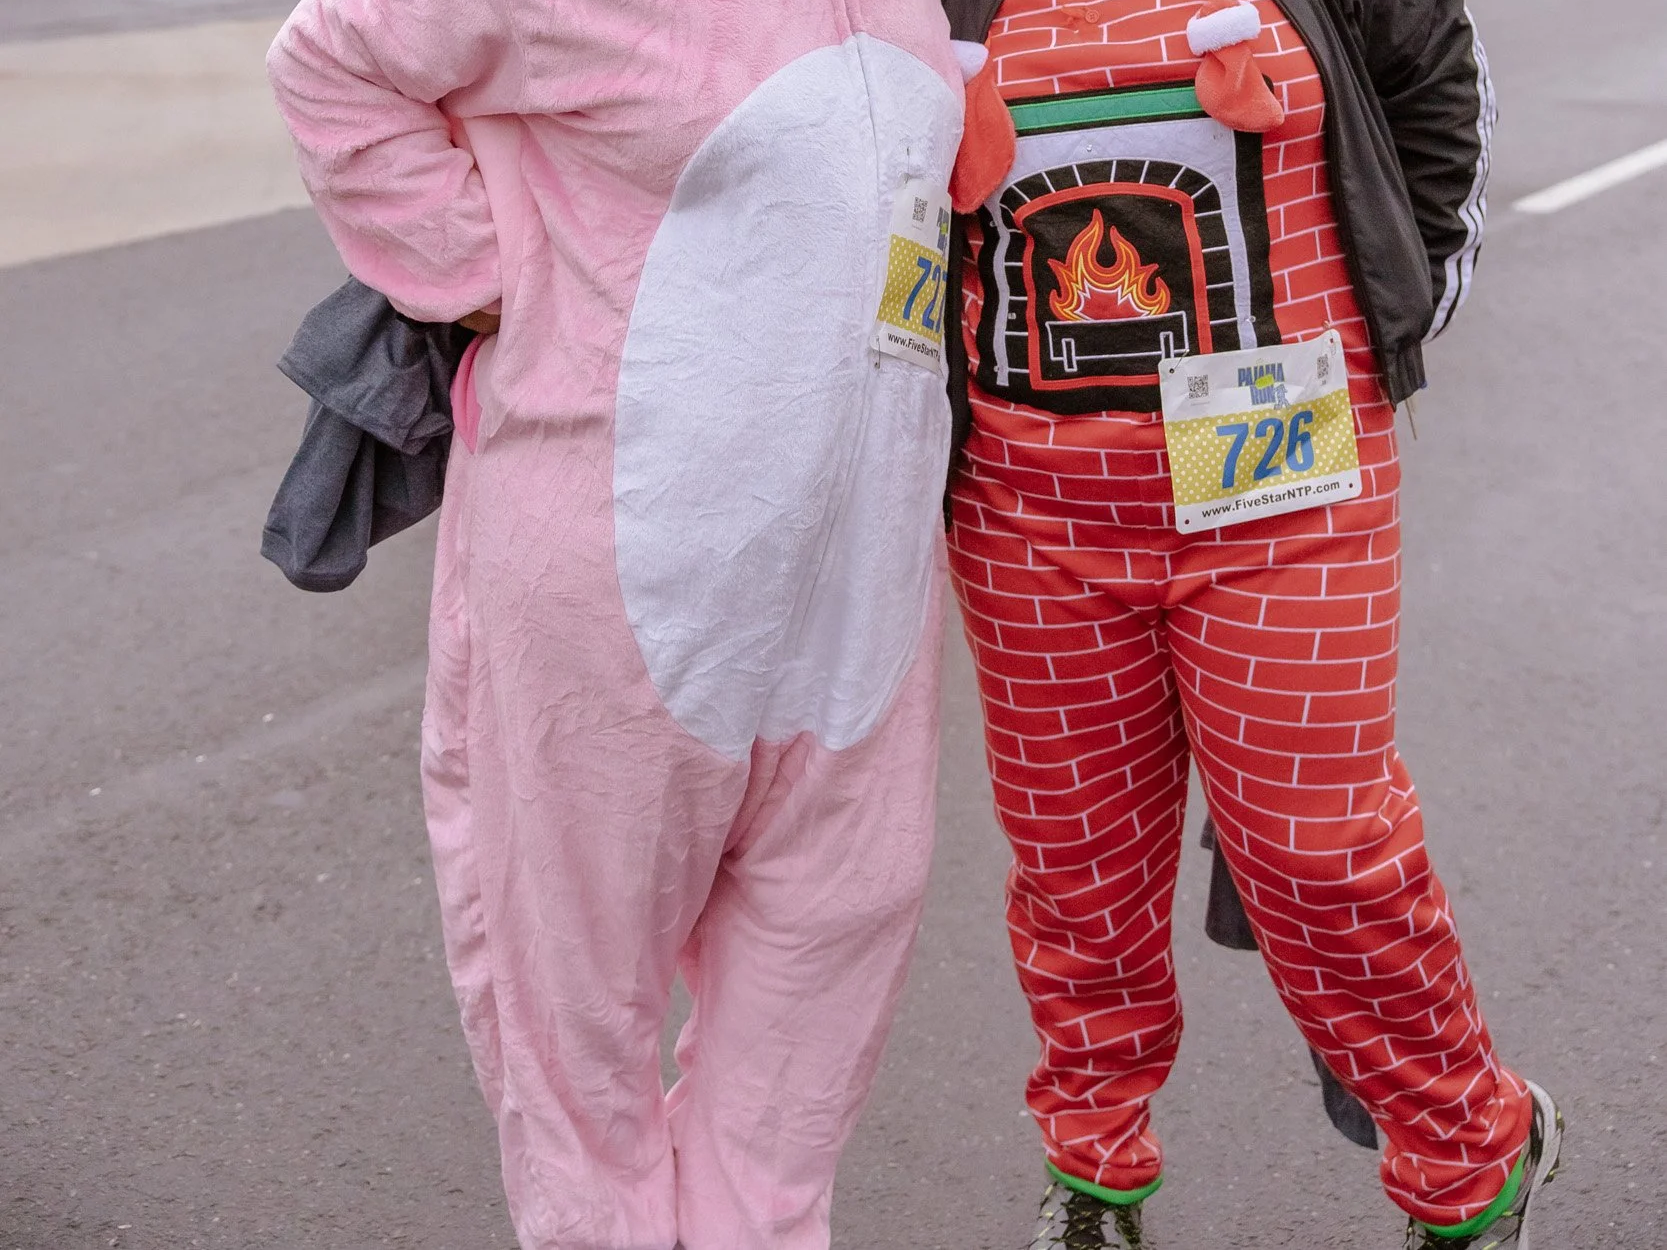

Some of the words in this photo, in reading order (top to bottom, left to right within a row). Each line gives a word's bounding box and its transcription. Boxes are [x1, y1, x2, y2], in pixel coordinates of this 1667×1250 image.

[1250, 385, 1275, 405] RUN
[1215, 409, 1316, 490] 726
[1202, 481, 1340, 518] www.FiveStarNTP.com
